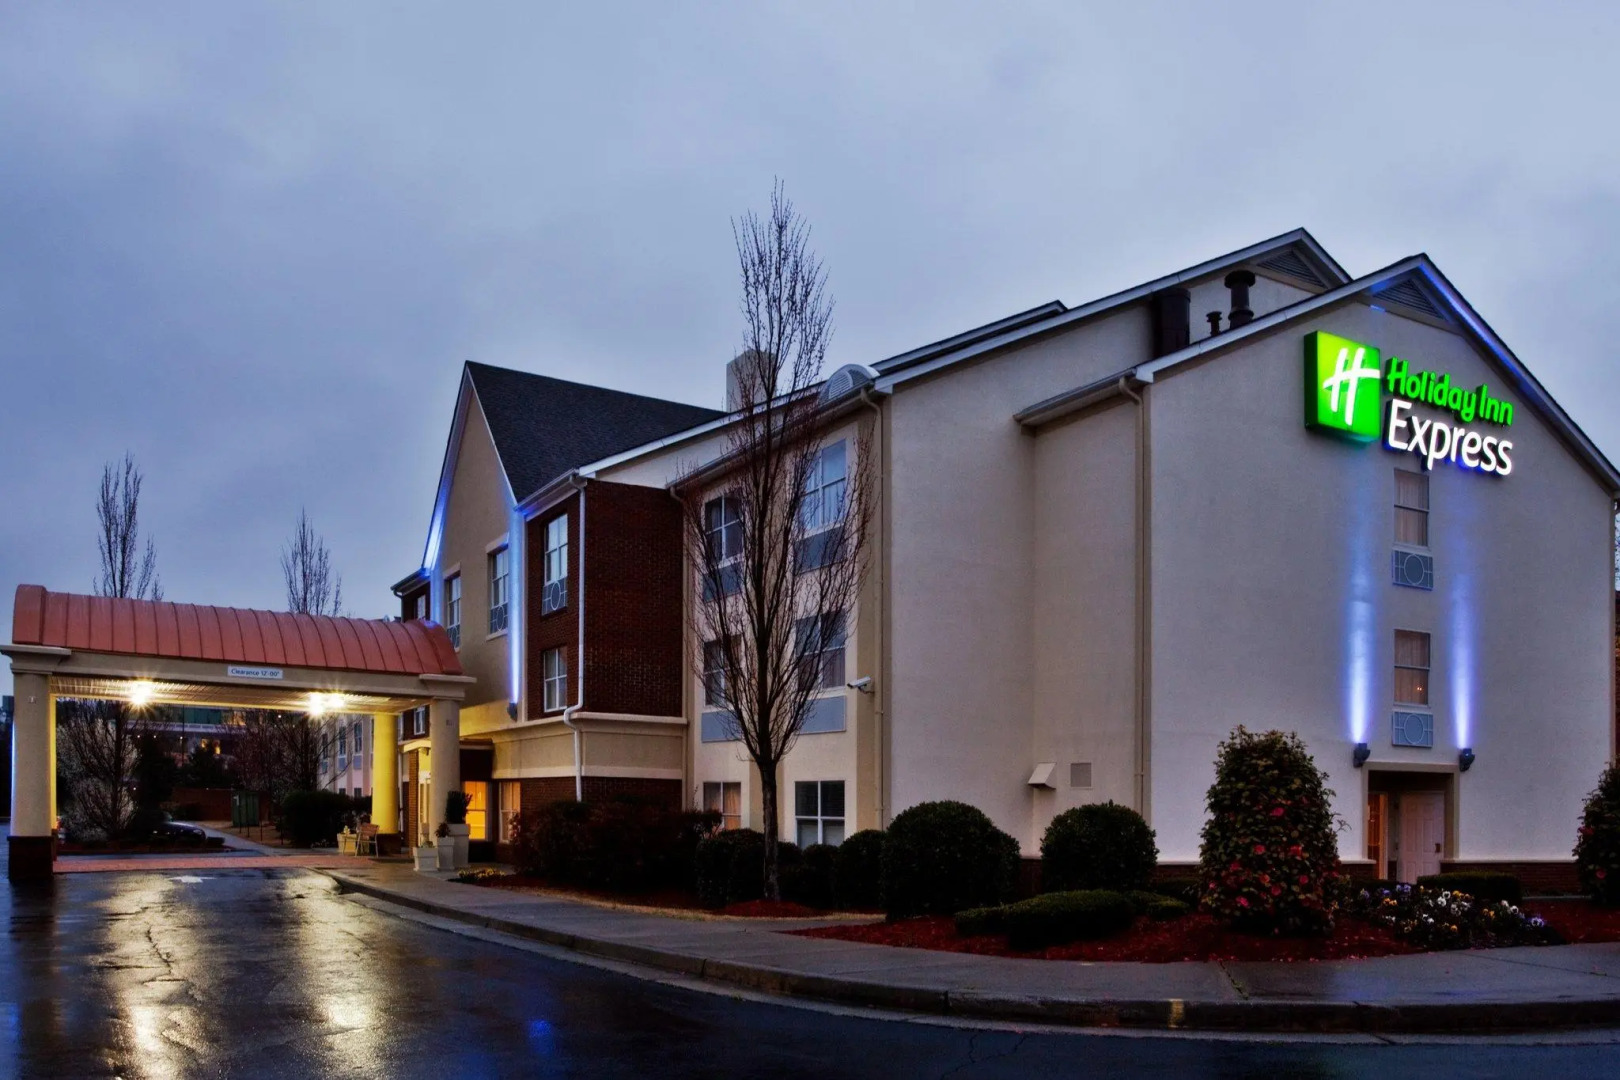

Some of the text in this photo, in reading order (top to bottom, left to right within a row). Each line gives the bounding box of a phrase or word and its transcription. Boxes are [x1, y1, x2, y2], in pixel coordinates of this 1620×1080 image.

[1387, 356, 1514, 427] Holiday Inn
[1388, 398, 1513, 476] Express
